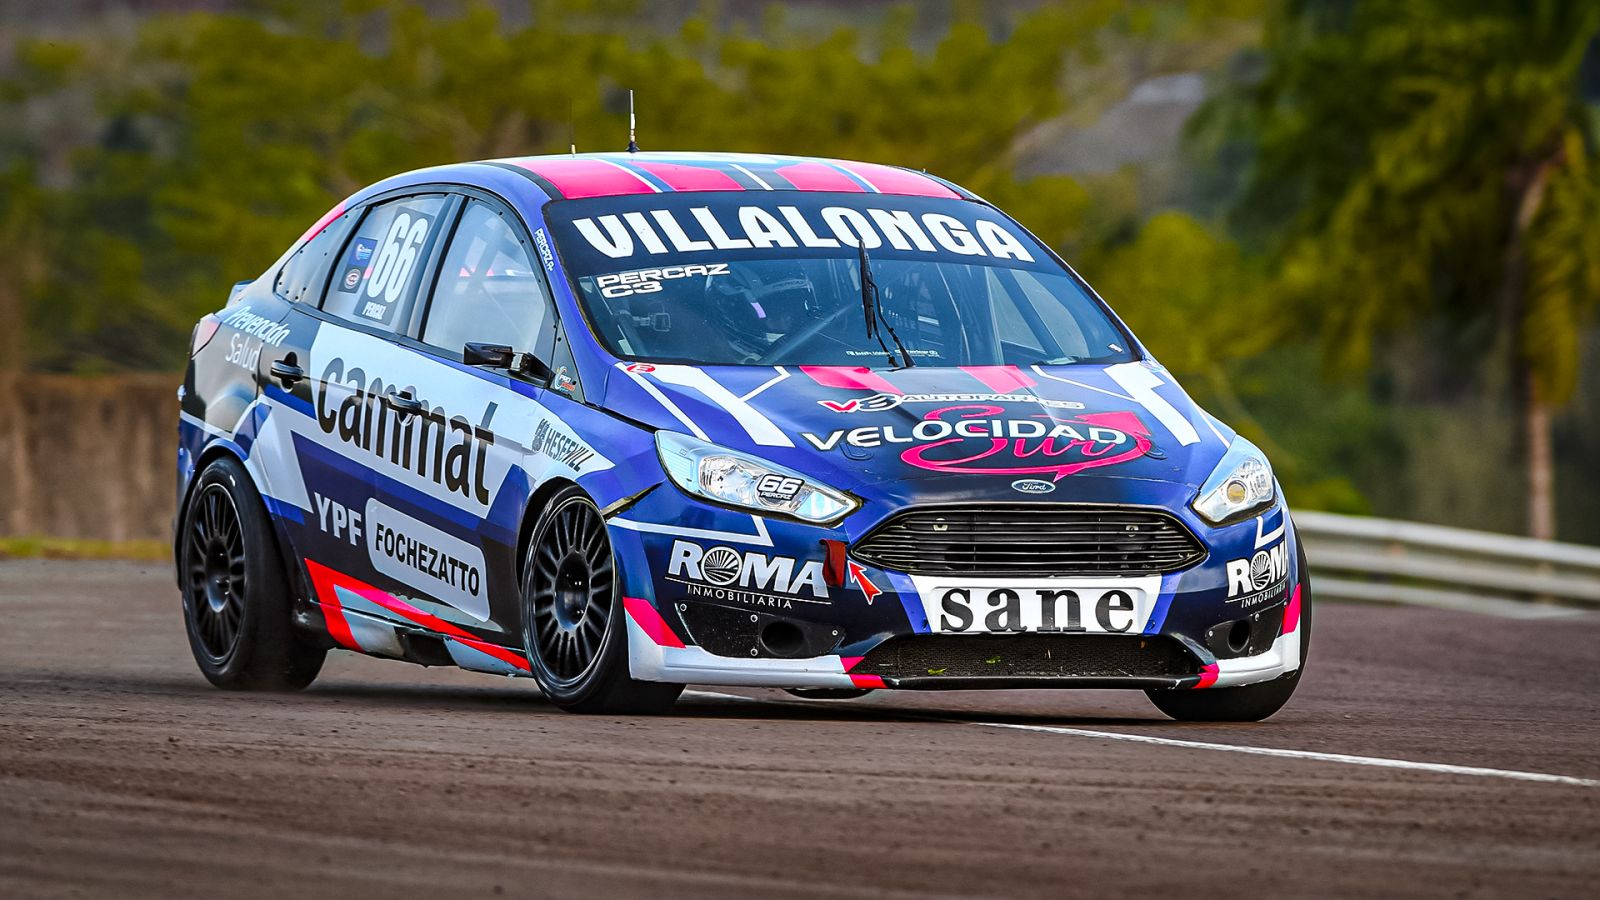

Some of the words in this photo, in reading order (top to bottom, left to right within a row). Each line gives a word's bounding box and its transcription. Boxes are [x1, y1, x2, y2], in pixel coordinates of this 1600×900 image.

[572, 206, 1036, 263] VILLALONGA
[367, 212, 429, 303] 66
[596, 263, 731, 288] PERCAZ
[601, 280, 663, 299] C3
[223, 305, 291, 347] Prevención
[225, 332, 264, 371] Salud
[316, 357, 499, 506] cammat
[802, 419, 1127, 451] VELOCIDAD
[758, 475, 803, 494] 66
[1022, 482, 1047, 491] Ford
[314, 491, 362, 546] YPF
[375, 522, 480, 597] FOCHEZATTO
[668, 539, 830, 599] ROMA
[1226, 540, 1288, 598] ROM
[687, 584, 793, 610] INMOBILIARIA
[940, 587, 1134, 633] sane
